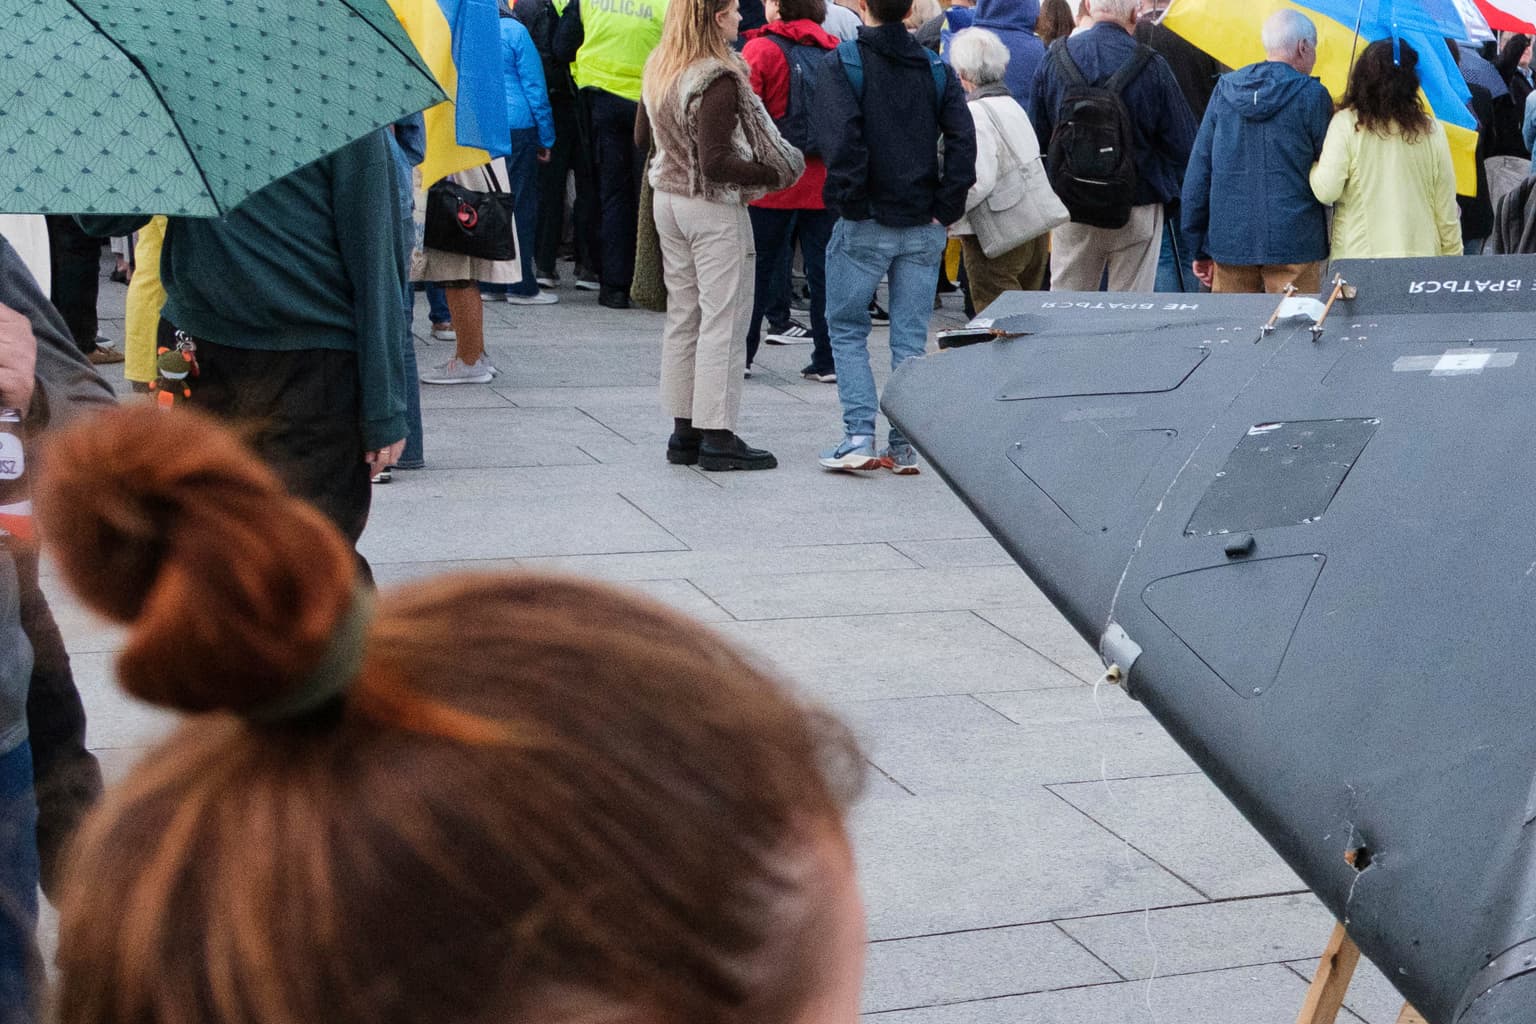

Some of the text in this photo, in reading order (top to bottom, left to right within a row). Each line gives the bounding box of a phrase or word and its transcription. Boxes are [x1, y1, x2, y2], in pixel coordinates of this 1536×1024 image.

[590, 0, 654, 18] POLICJA
[1408, 279, 1522, 293] БРАТЬСЯ
[1041, 301, 1199, 310] НЕ БРАТЬСЯ
